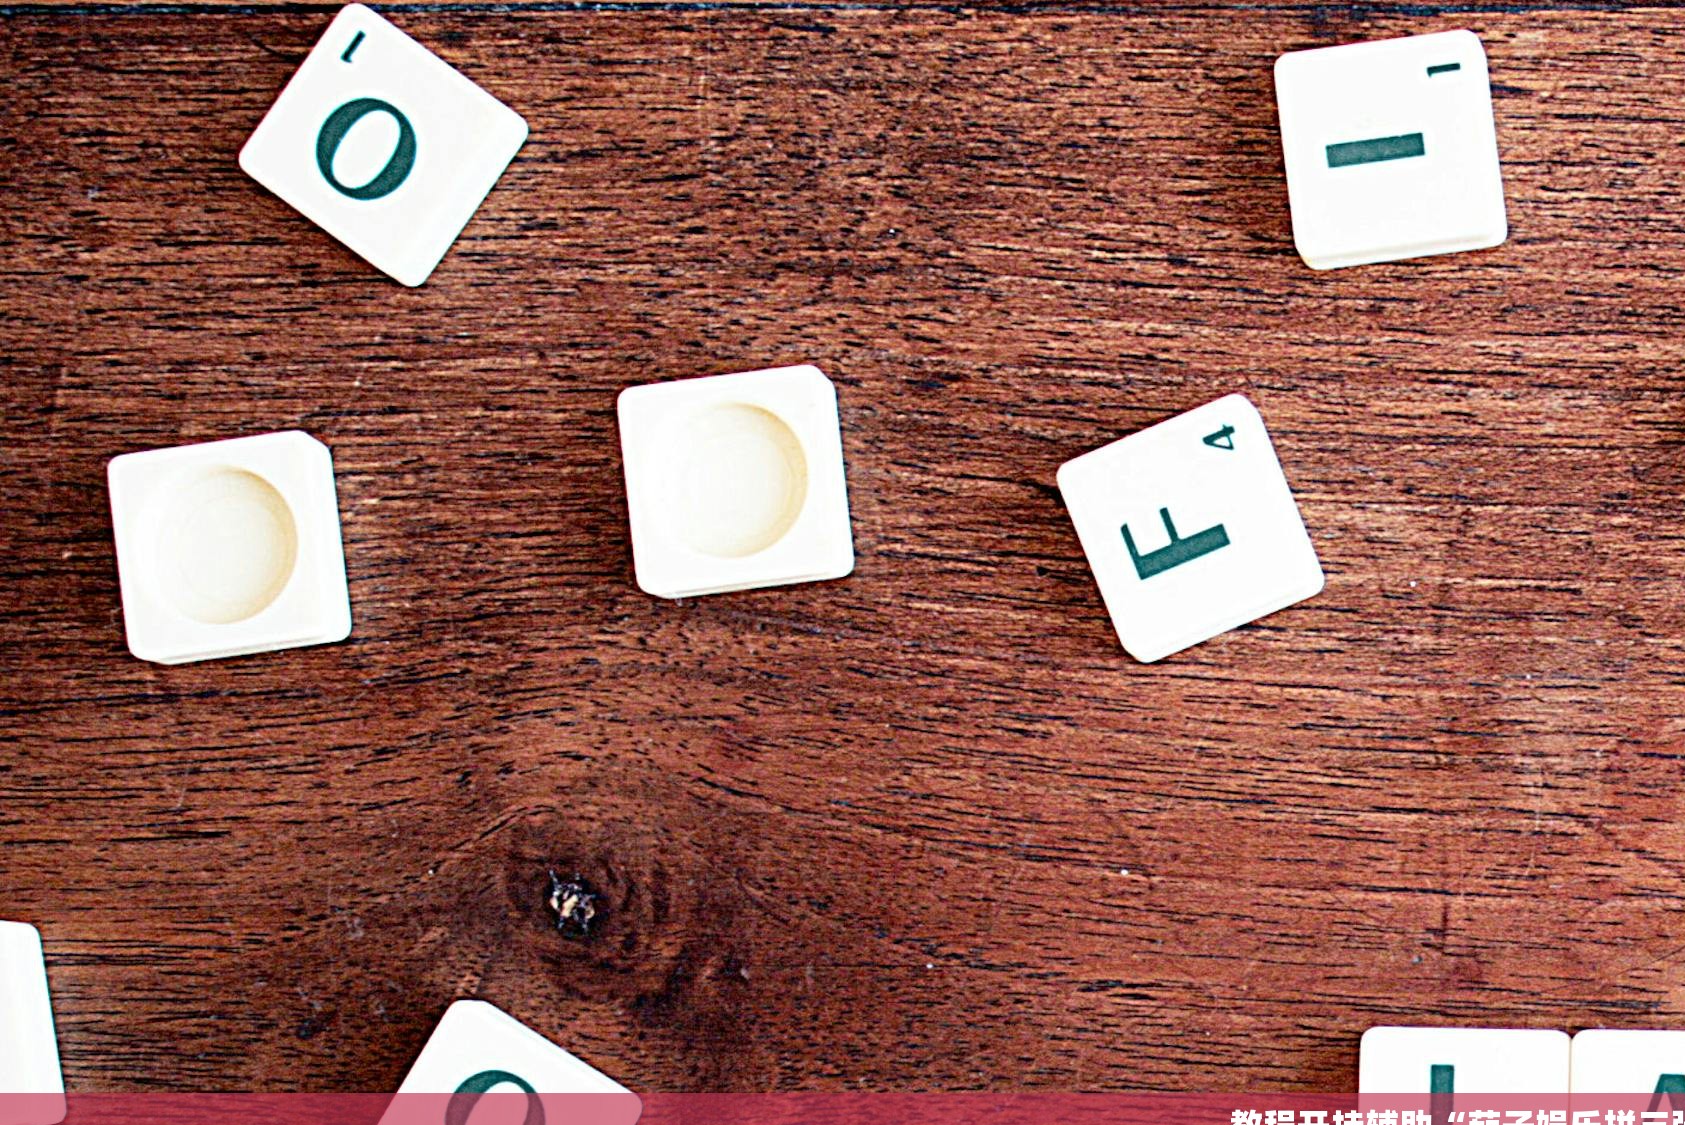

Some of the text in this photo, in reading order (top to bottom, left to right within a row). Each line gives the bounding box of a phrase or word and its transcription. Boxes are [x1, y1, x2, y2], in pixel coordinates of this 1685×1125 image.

[339, 29, 367, 64] 1
[1425, 61, 1462, 78] 1
[315, 97, 417, 201] O
[1325, 132, 1426, 168] I
[1201, 423, 1236, 452] 4
[1120, 507, 1231, 581] F
